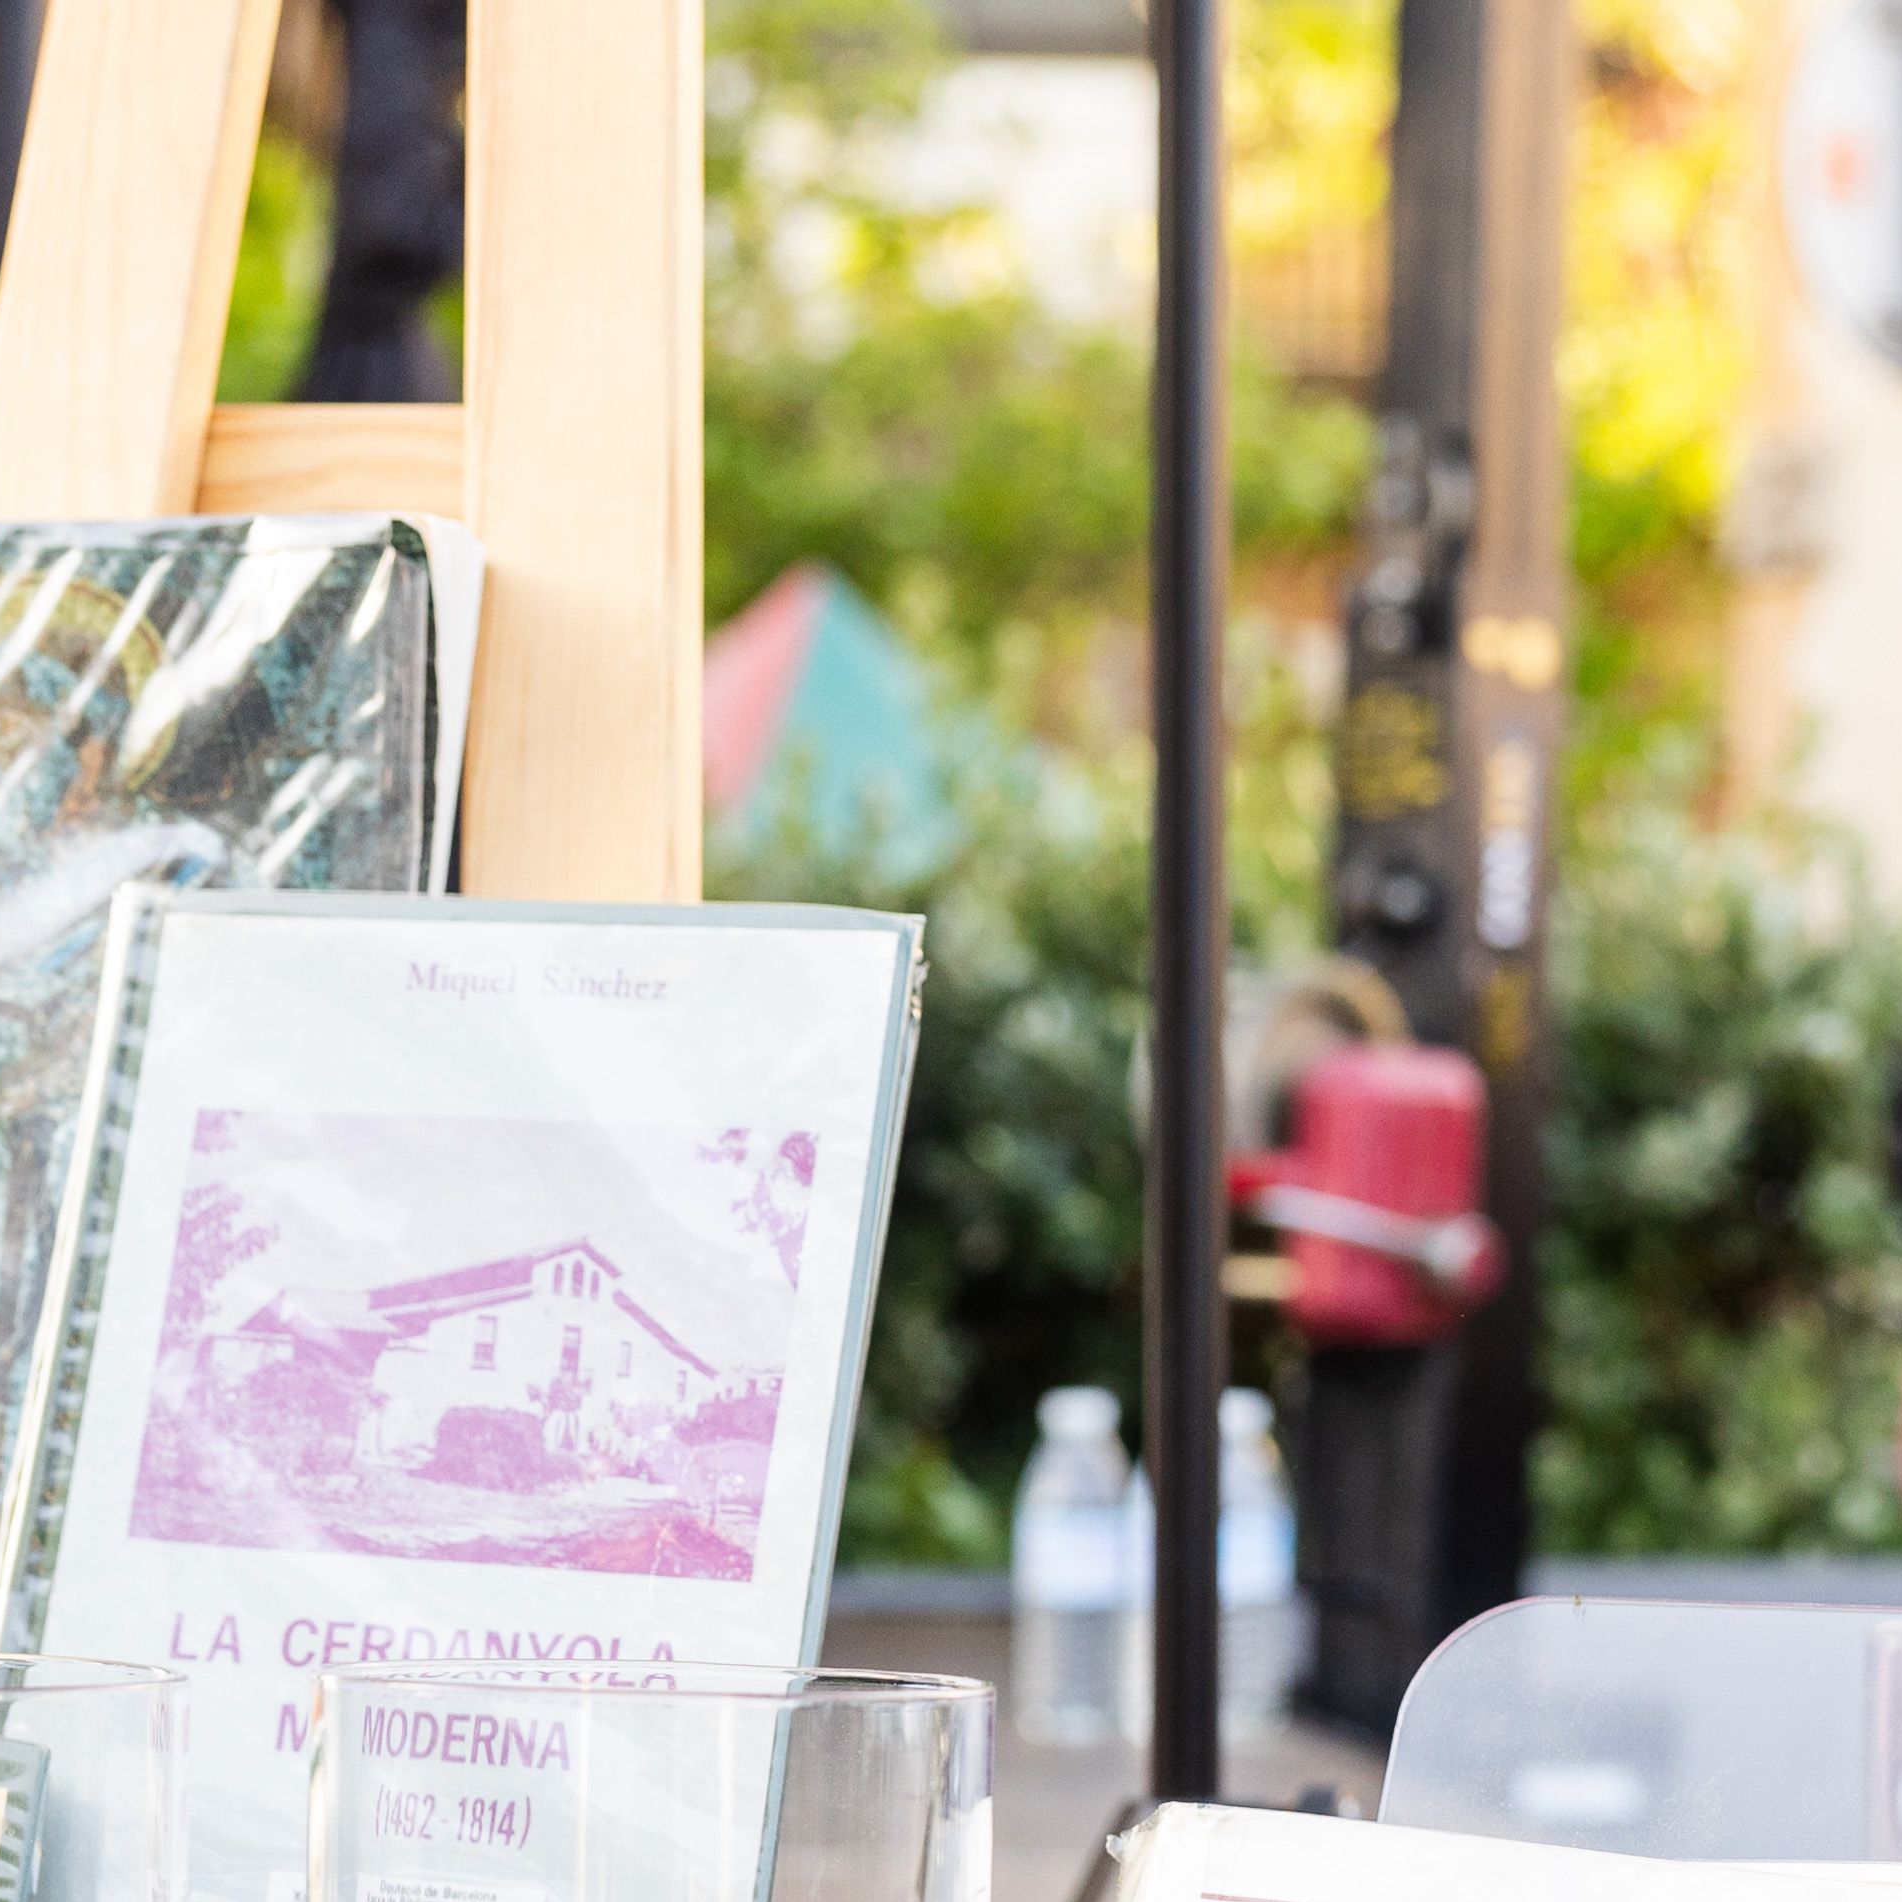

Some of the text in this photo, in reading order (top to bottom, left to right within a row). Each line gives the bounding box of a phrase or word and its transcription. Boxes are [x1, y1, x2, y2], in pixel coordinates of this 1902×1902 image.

[405, 958, 516, 1001] Miquel
[170, 1612, 678, 1684] LA CERDANYOLA
[361, 1704, 571, 1771] MODERNA
